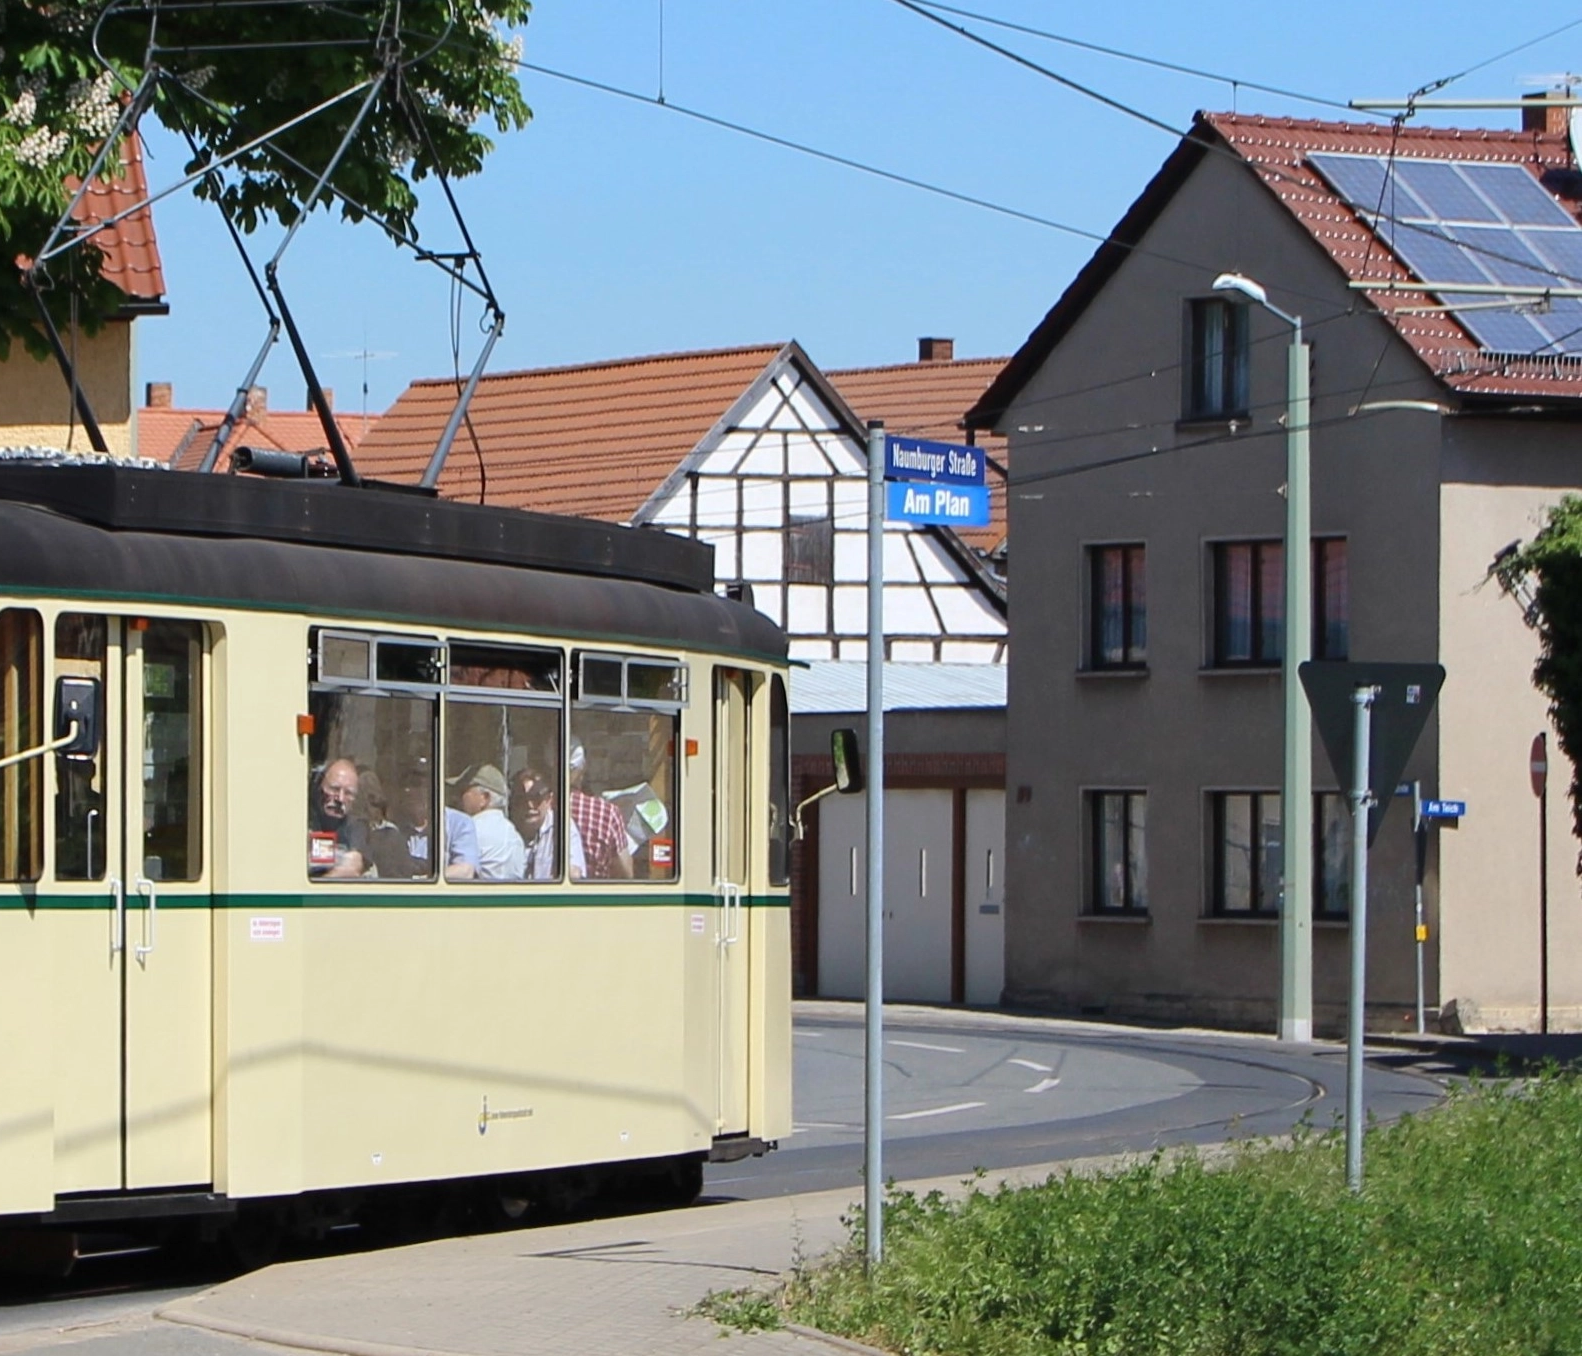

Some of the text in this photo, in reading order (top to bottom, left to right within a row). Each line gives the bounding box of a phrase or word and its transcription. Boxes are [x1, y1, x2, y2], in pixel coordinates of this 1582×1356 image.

[893, 443, 977, 478] Naumburger Straße
[903, 488, 969, 517] Am Plan
[1428, 801, 1440, 813] Am
